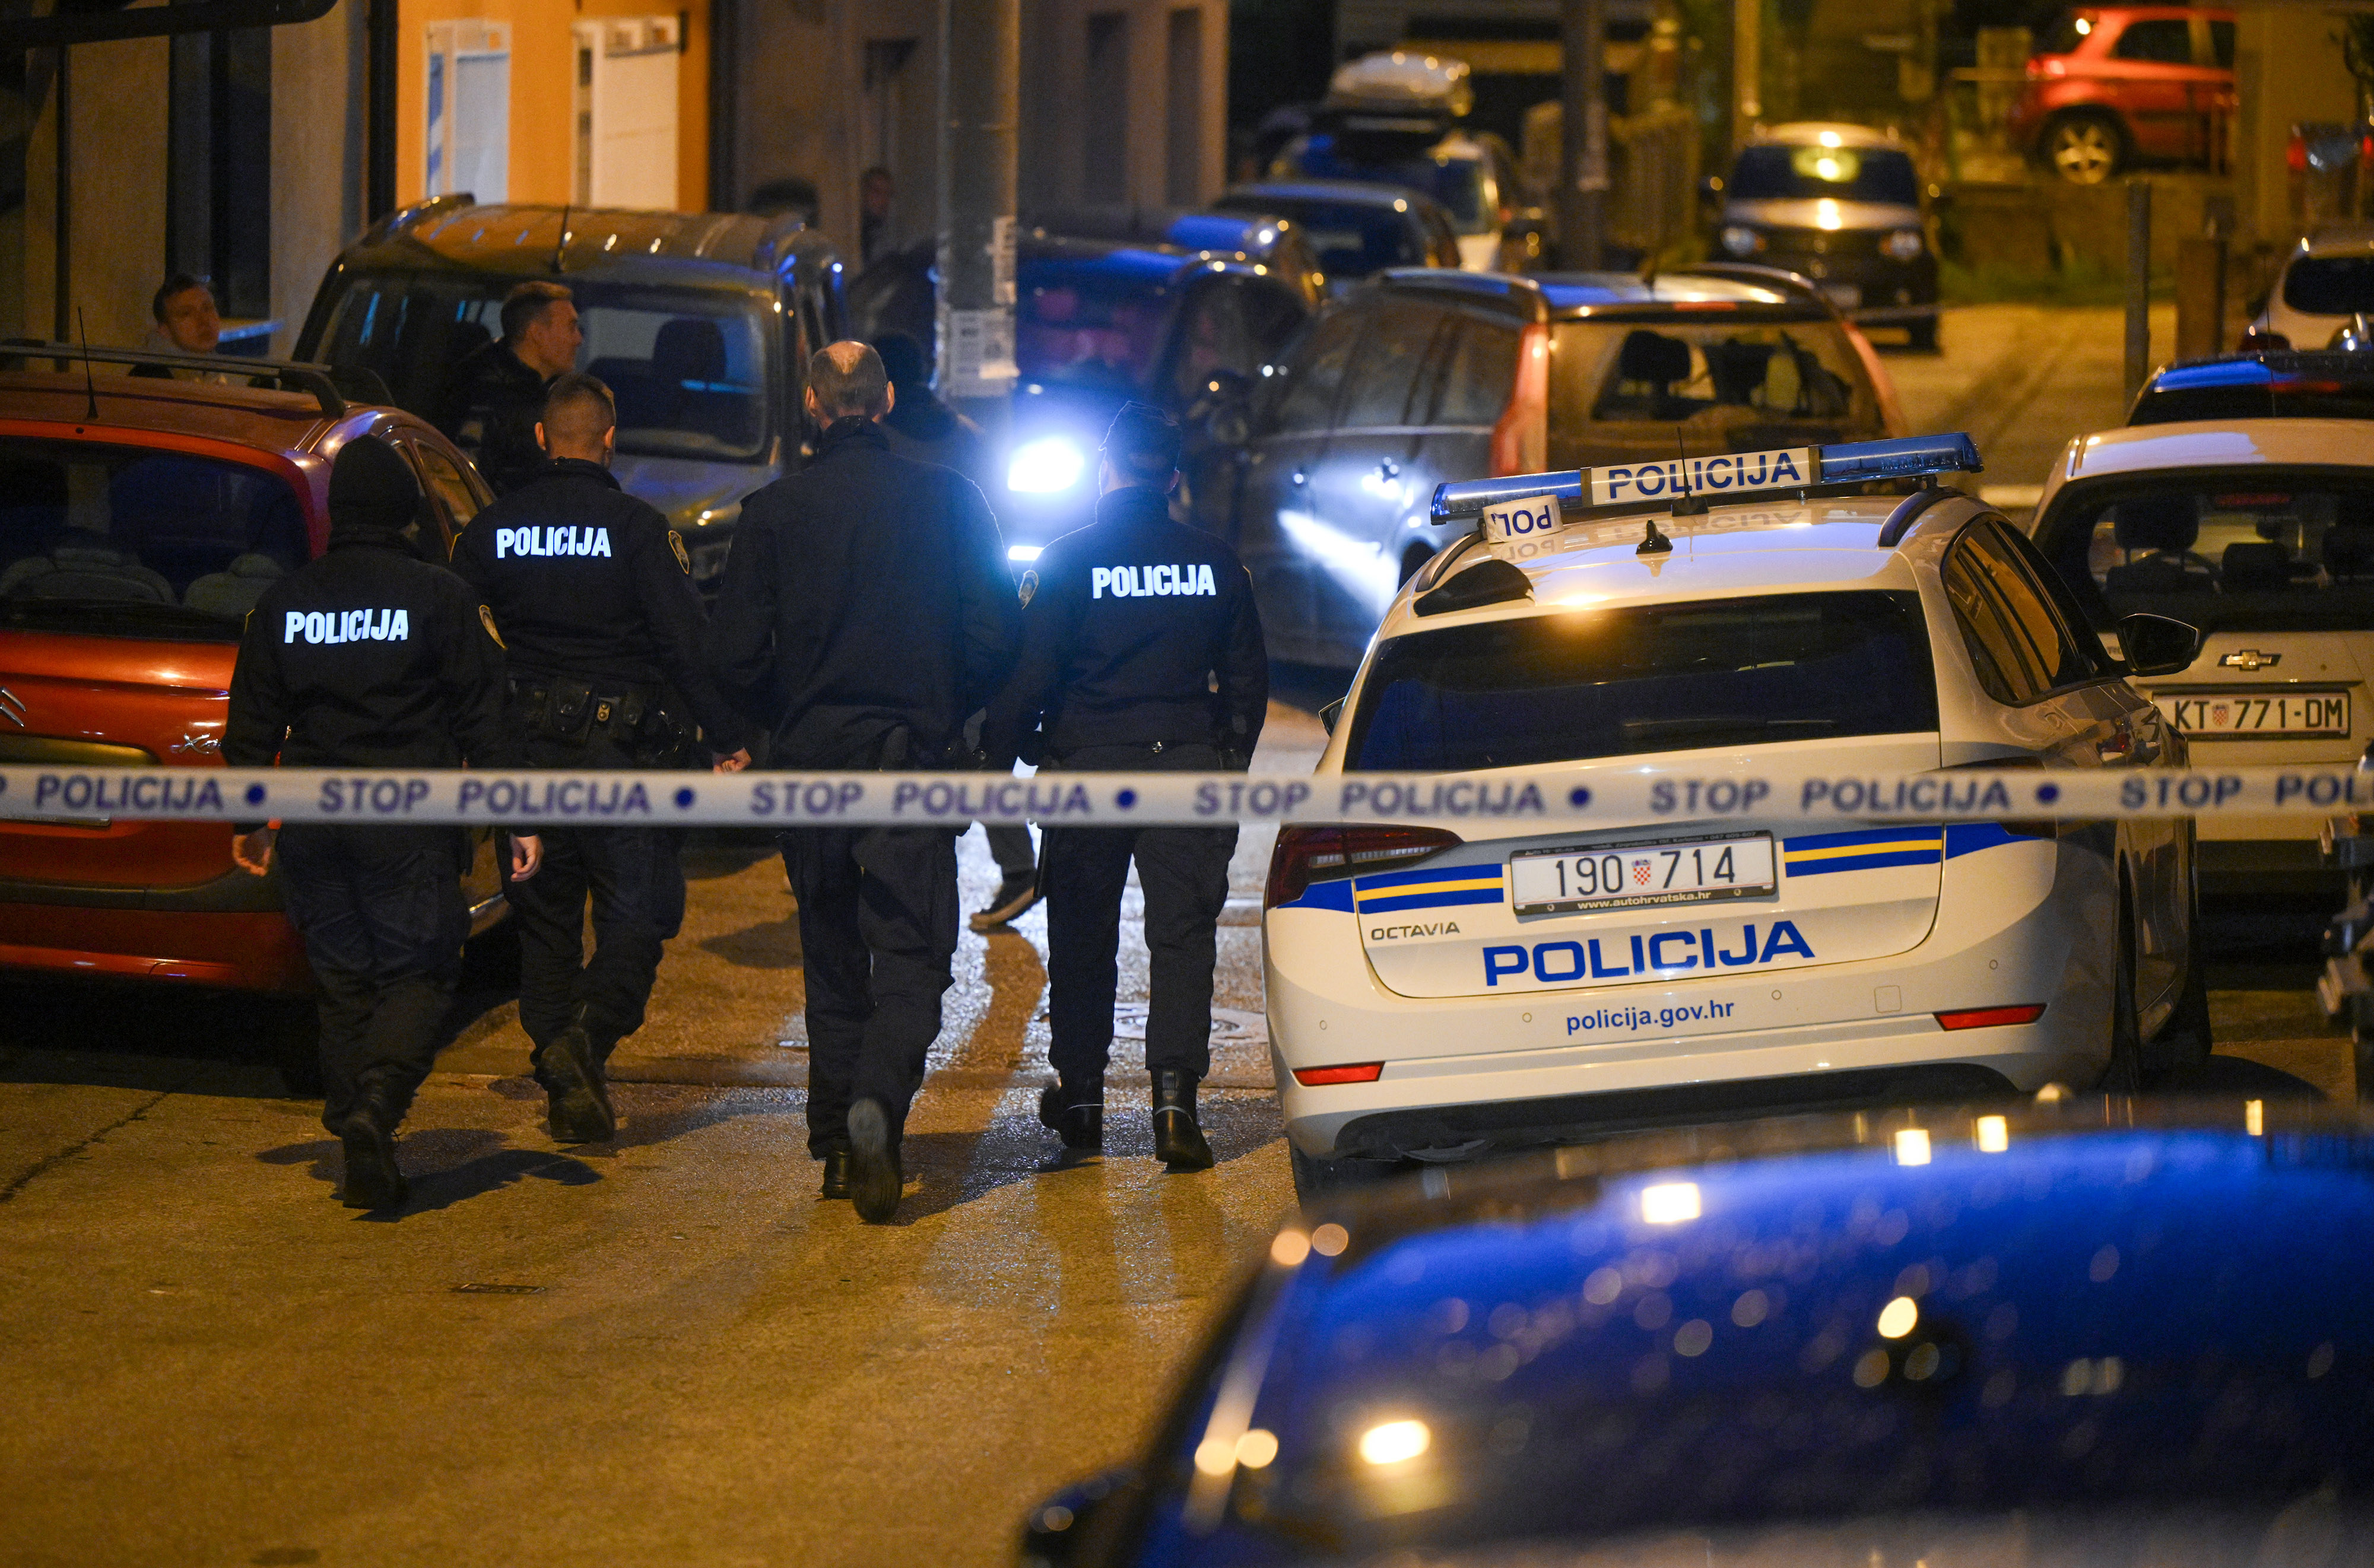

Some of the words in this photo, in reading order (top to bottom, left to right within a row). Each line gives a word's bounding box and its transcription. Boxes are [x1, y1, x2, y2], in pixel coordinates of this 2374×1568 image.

[1608, 452, 1801, 499] POLICIJA
[497, 526, 611, 558] POLICIJA
[1091, 564, 1217, 599] POLICIJA
[284, 608, 409, 644] POLICIJA
[2175, 699, 2210, 730] KT
[36, 773, 224, 810] POLICIJA
[319, 777, 429, 814] STOP
[457, 779, 651, 814] POLICIJA
[750, 780, 864, 817] STOP
[893, 780, 1091, 817] POLICIJA
[1193, 780, 1310, 817] STOP
[1339, 780, 1545, 817] POLICIJA
[1649, 778, 1770, 814] STOP
[1799, 777, 2011, 813] POLICIJA
[2120, 775, 2242, 810] STOP
[2274, 774, 2374, 807] POL
[1556, 855, 1623, 897] 190
[1660, 846, 1735, 889] 714
[1578, 891, 1712, 910] www.autohrvatska.hr
[1371, 921, 1461, 940] OCTAVIA
[1483, 920, 1816, 986] POLICIJA
[1566, 1000, 1734, 1035] policija.gov.hr
